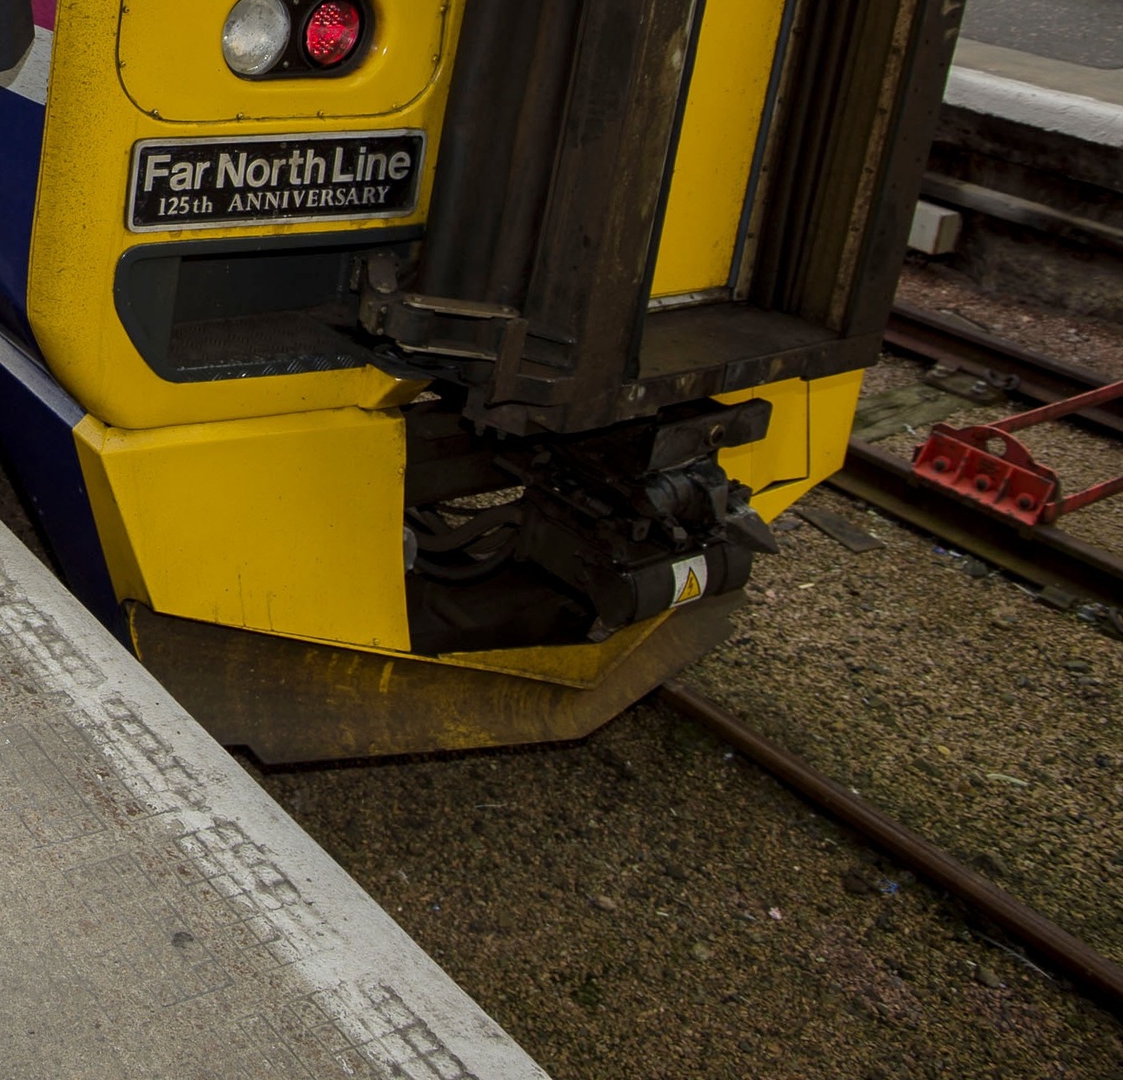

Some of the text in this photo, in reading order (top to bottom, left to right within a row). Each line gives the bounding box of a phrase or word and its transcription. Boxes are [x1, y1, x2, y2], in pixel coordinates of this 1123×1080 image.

[143, 147, 411, 192] Far North Line
[158, 185, 391, 216] 125th ANNIVERSARY
